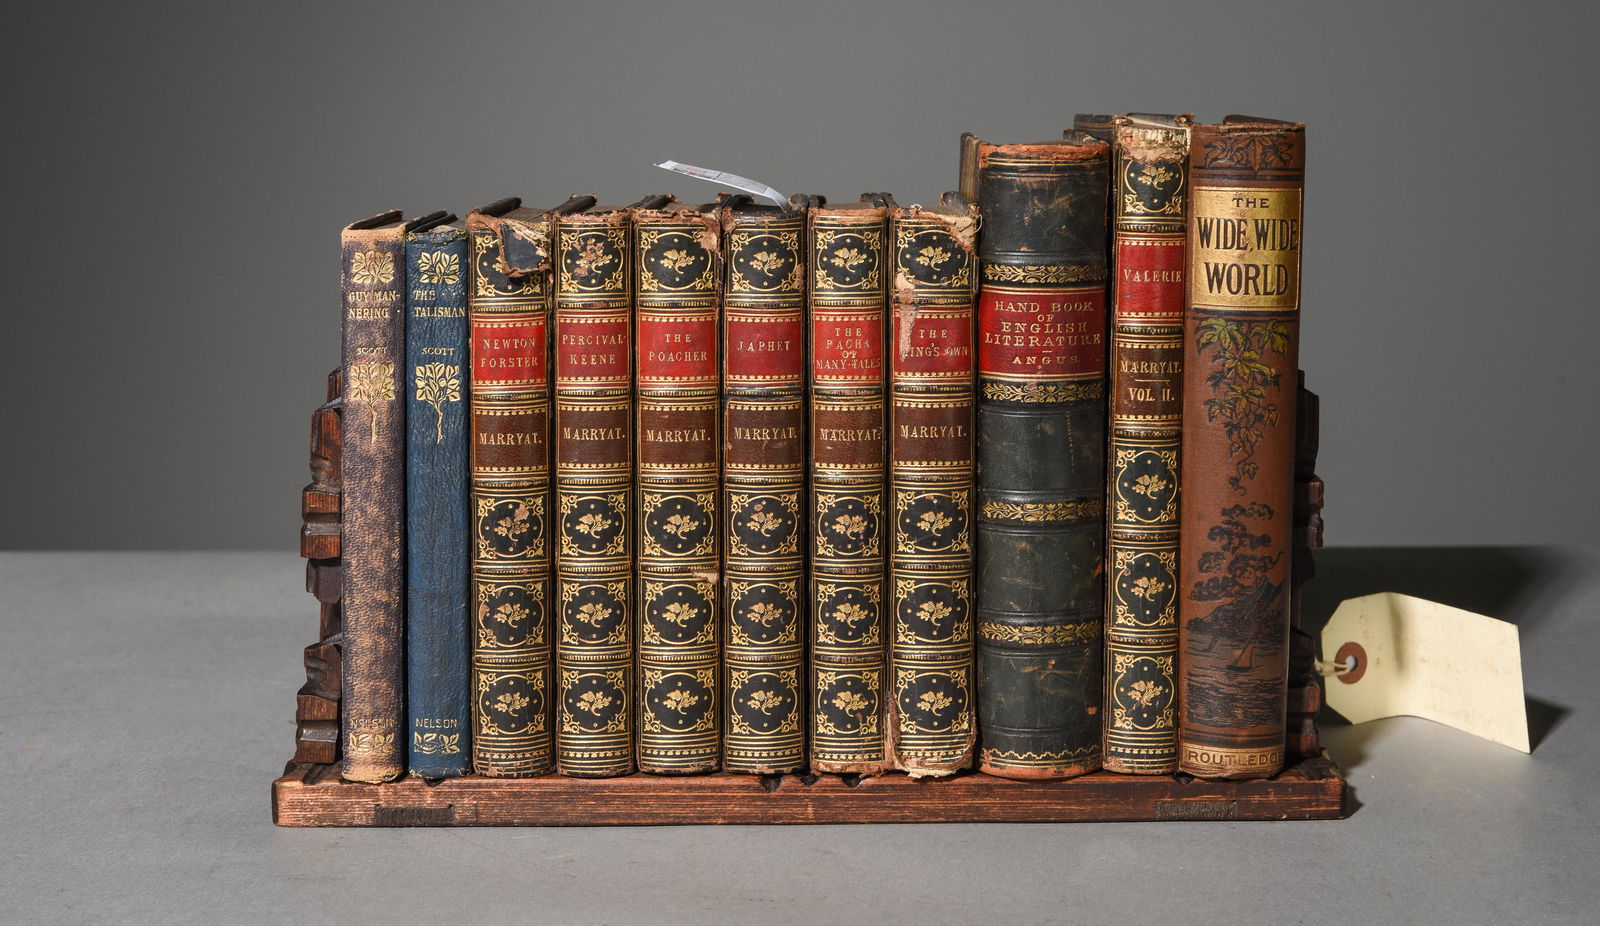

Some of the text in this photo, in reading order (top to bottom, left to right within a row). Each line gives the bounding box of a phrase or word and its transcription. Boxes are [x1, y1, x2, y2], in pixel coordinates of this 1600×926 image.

[1231, 197, 1270, 208] THE
[1254, 218, 1297, 251] WIDE
[1123, 269, 1183, 283] VALERIE
[1203, 261, 1289, 296] WORLD
[349, 290, 370, 302] GUY
[414, 290, 436, 301] THE
[349, 307, 390, 319] NERING
[414, 306, 465, 318] TALISMAN
[994, 301, 1094, 313] HAND BOOK
[1037, 314, 1055, 322] OF
[835, 327, 862, 337] THE
[1001, 321, 1088, 334] ENGLISH
[562, 334, 624, 345] PERCIVAL
[664, 333, 692, 343] THE
[918, 329, 948, 339] THE
[985, 332, 1101, 347] LITERATURE
[483, 338, 536, 350] NEWTON
[737, 340, 791, 352] JAPHET
[826, 338, 870, 350] PACHA
[421, 347, 455, 356] SCOTT
[648, 351, 708, 362] POACHER
[480, 356, 539, 369] FORSTER
[569, 354, 616, 365] KEENE
[1012, 356, 1078, 365] ANGUS
[1128, 387, 1175, 402] VOL. II.
[563, 427, 626, 441] MARRYAT.
[646, 429, 712, 443] MARRYAT.
[734, 426, 798, 441] MARRYAT.
[900, 425, 967, 439] MARRYAT.
[479, 432, 542, 446] MARRYAT.
[415, 718, 458, 729] NELSON
